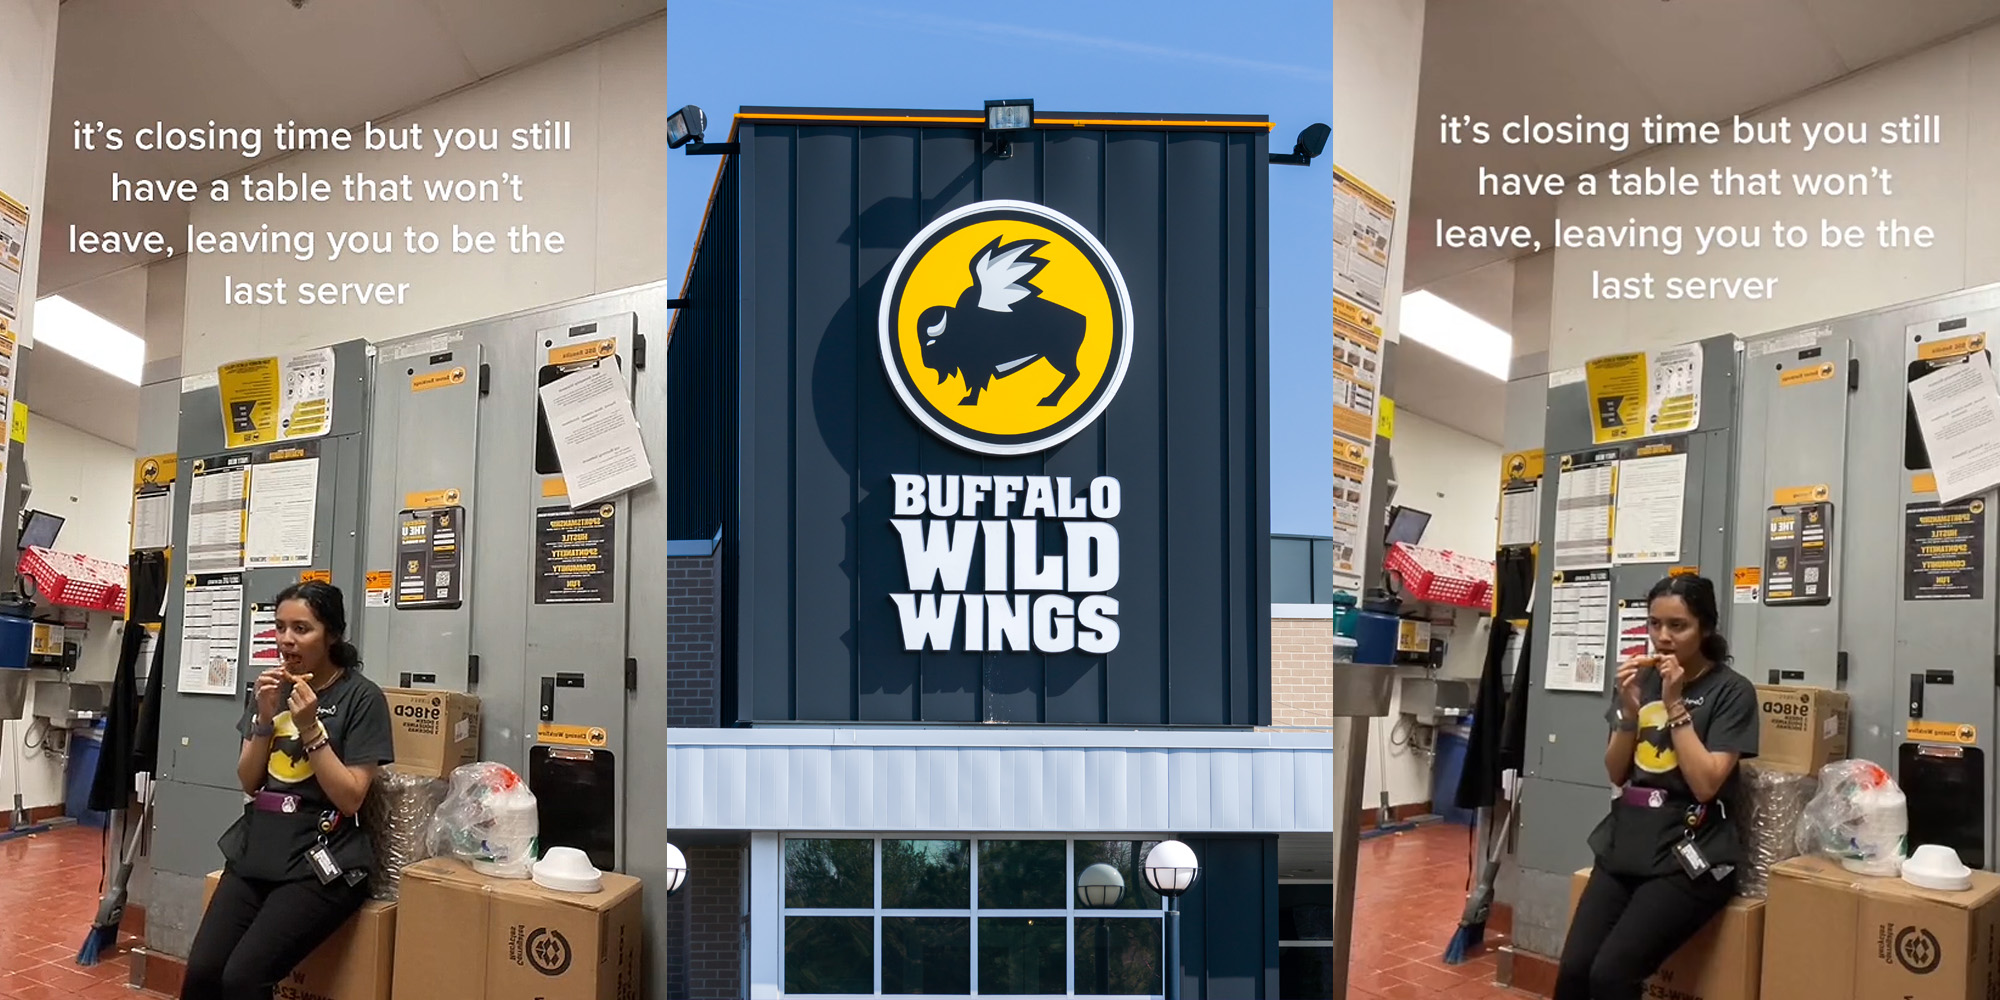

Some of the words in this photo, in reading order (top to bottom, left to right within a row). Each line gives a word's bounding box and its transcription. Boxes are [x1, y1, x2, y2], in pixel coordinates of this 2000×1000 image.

[891, 473, 1121, 519] BUFFALO
[889, 518, 1120, 593] WILD
[888, 592, 1121, 654] WINGS
